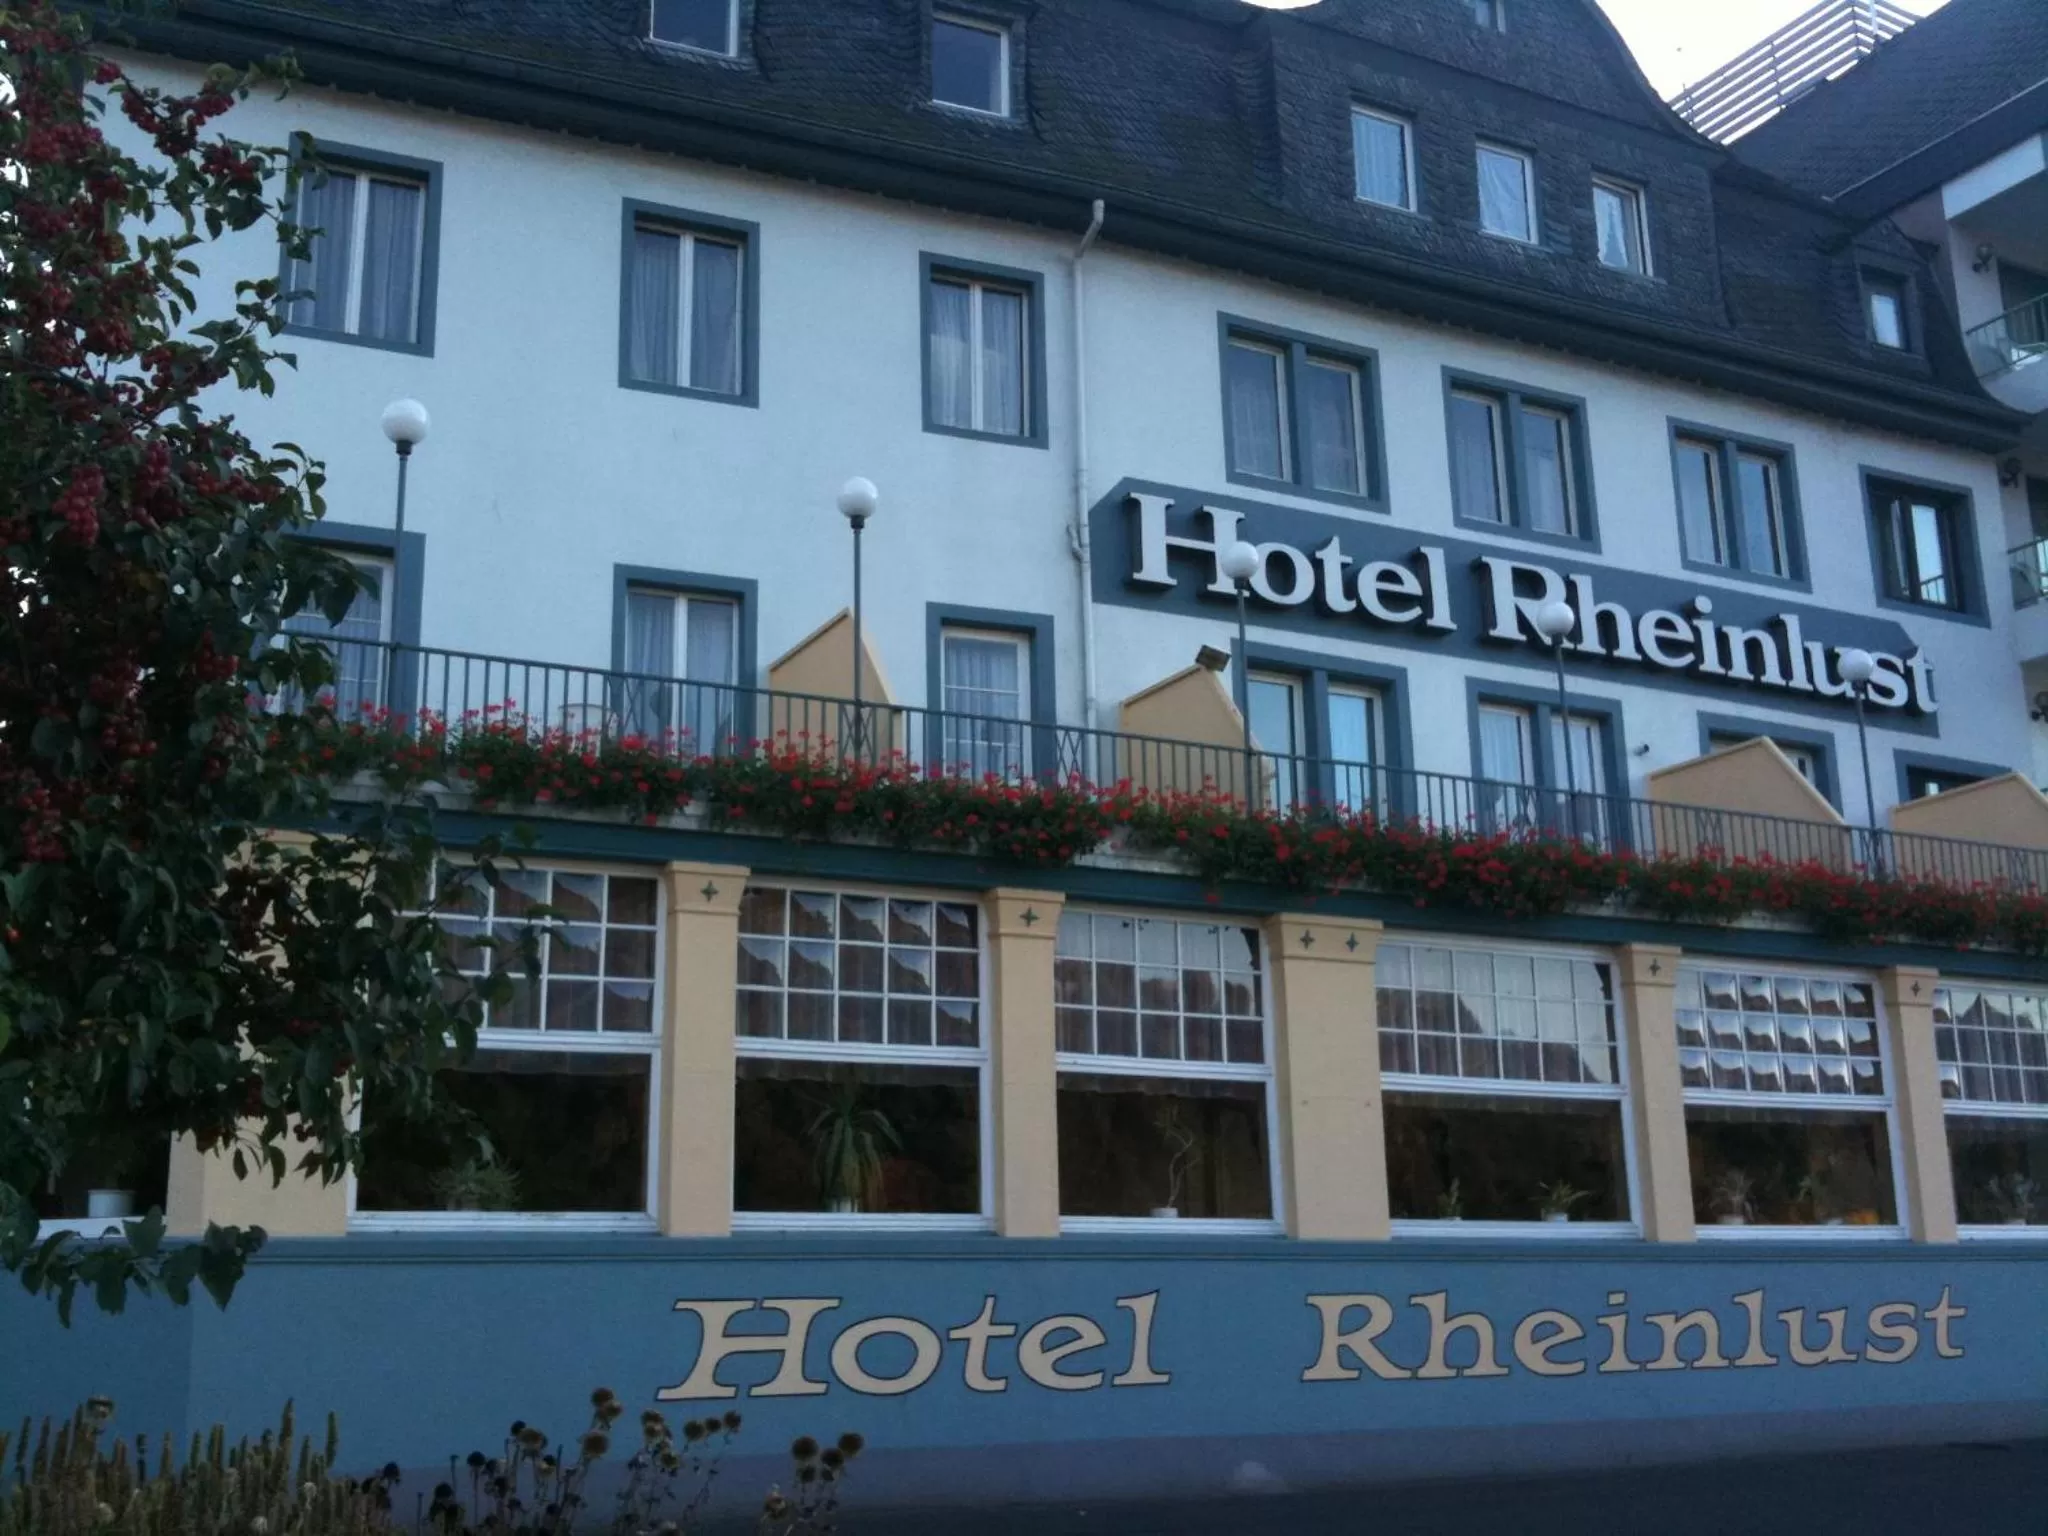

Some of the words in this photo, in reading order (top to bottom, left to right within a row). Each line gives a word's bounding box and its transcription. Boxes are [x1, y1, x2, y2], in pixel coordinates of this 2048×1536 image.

[1128, 492, 1457, 631] Hotel
[1481, 556, 1939, 713] Rheinlust
[656, 1291, 1172, 1401] Hotel
[1302, 1286, 1967, 1382] Rheinlust
